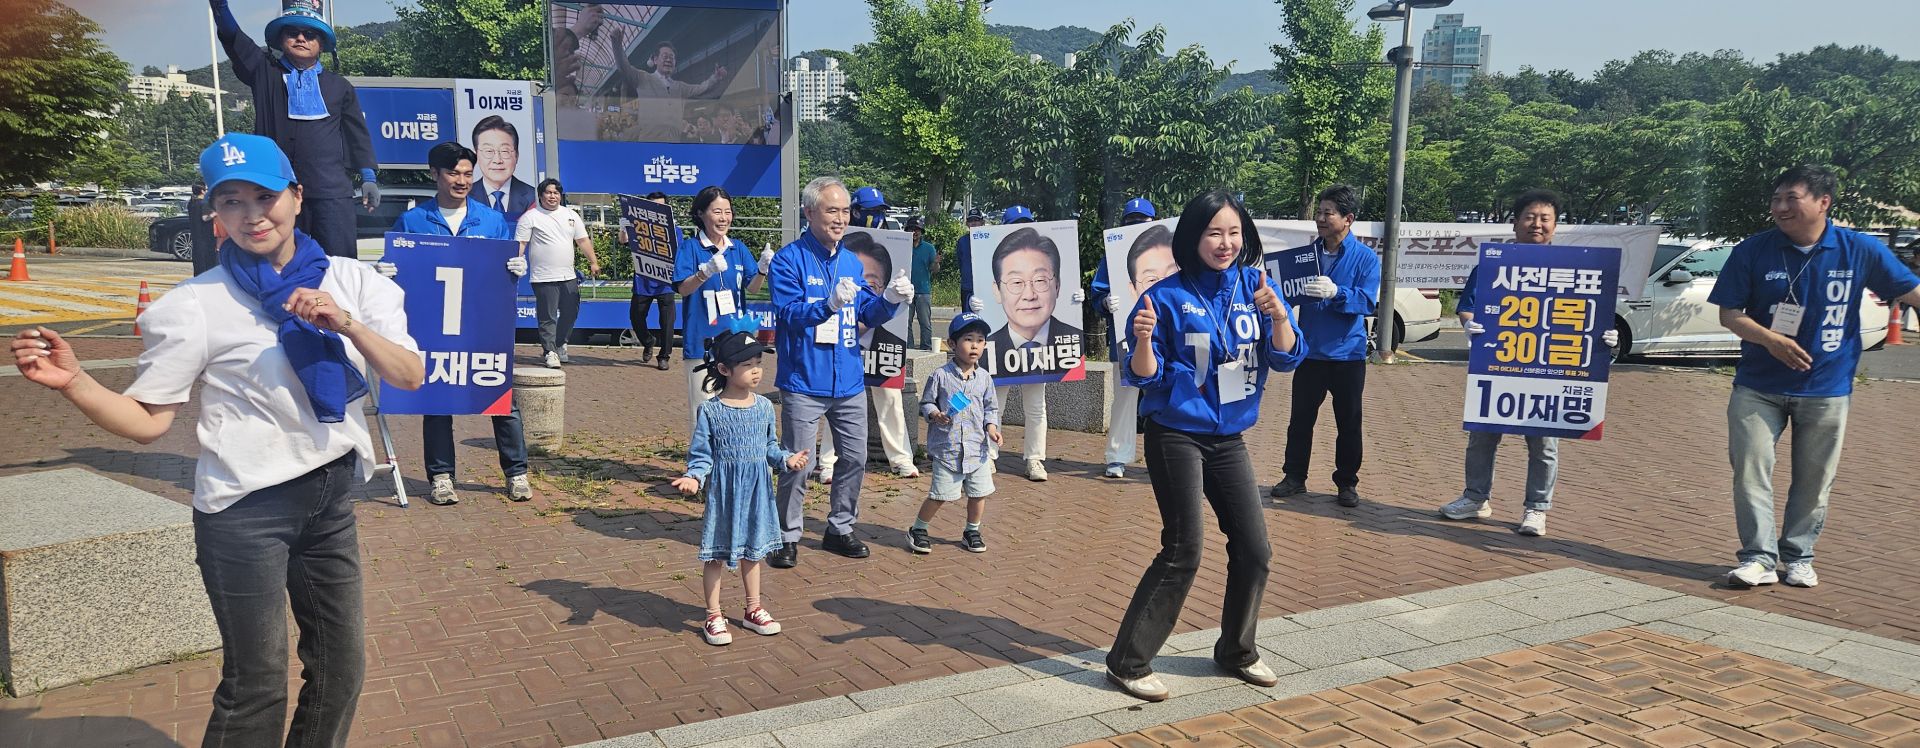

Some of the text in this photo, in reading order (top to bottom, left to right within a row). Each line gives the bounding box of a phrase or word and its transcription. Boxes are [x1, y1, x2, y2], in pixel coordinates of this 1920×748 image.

[464, 88, 476, 110] 1
[478, 96, 523, 111] 이재명
[381, 121, 439, 140] 이재명
[220, 142, 246, 166] LA
[652, 155, 672, 165] 더불어
[644, 164, 700, 184] 민주당
[872, 189, 878, 198] 1
[1016, 206, 1022, 214] 1
[1134, 200, 1139, 208] 1
[628, 206, 668, 226] 사전투표
[972, 232, 990, 240] 민주당
[1106, 234, 1124, 242] 민주당
[636, 255, 644, 273] 1
[1294, 252, 1316, 264] 지금은
[1266, 260, 1282, 292] 1
[1492, 265, 1602, 295] 사전투표
[1828, 270, 1853, 278] 지금은
[436, 266, 464, 336] 1
[703, 290, 718, 326] 1
[1232, 302, 1256, 312] 지금은
[517, 307, 536, 318] 진짜
[1182, 302, 1206, 317] 민주당
[1484, 304, 1500, 315] 5월
[1822, 279, 1852, 352] 이재명
[1054, 334, 1080, 344] 지금은
[878, 343, 903, 353] 지금은
[986, 342, 998, 375] 1
[1004, 344, 1081, 373] 이재명
[1184, 332, 1210, 389] 1
[1477, 380, 1492, 418] 1
[1562, 386, 1594, 396] 지금은
[1496, 392, 1593, 424] 이재명
